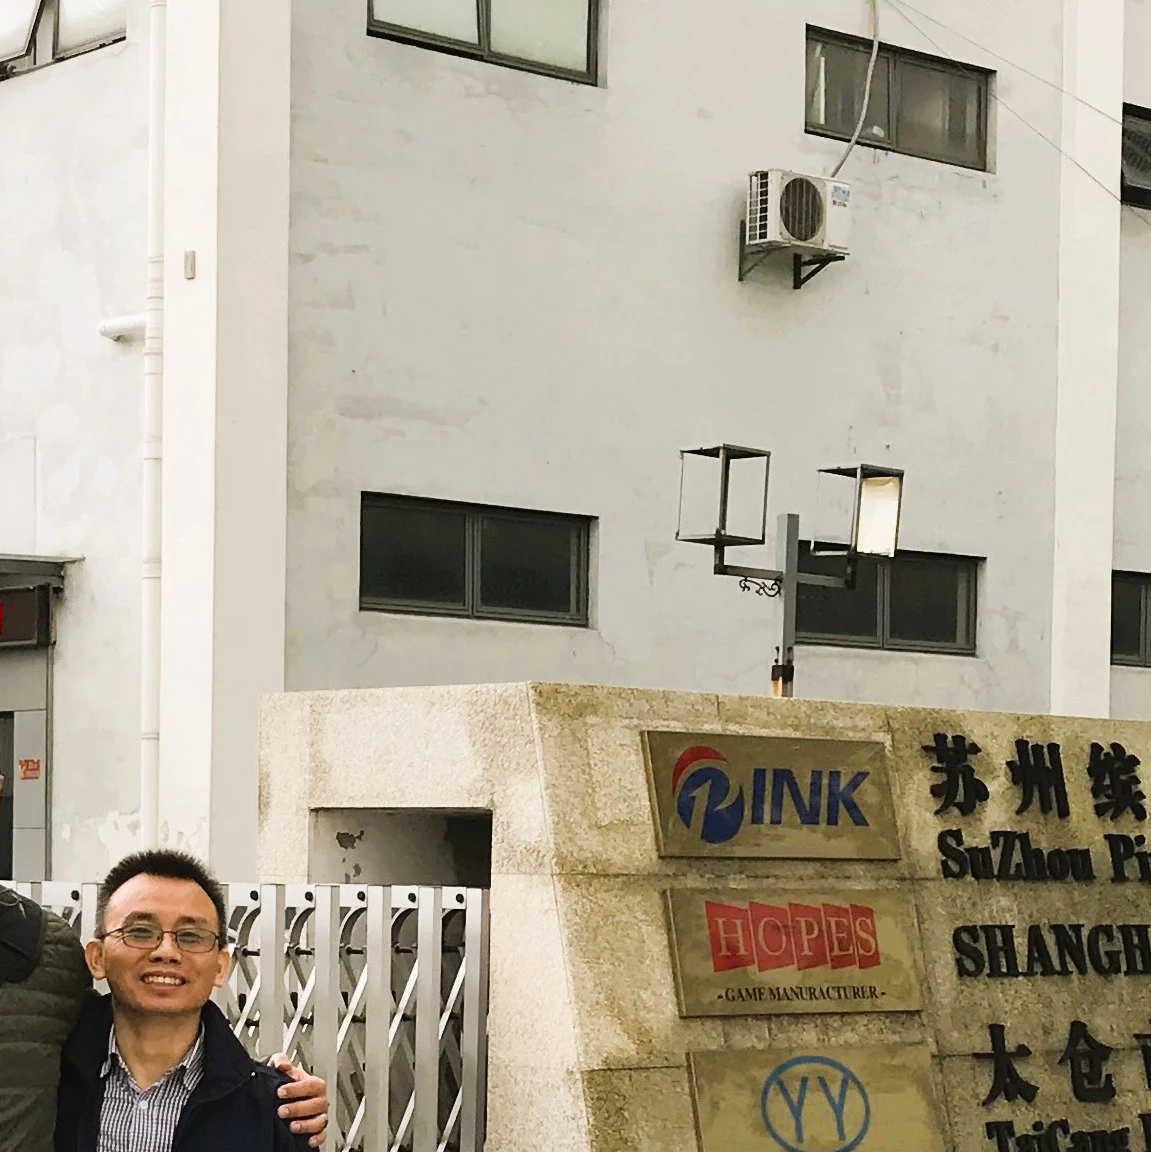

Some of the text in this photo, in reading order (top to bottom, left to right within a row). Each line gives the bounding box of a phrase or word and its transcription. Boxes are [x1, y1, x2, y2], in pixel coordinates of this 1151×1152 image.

[937, 829, 1151, 883] SuZhou Pi
[715, 917, 877, 956] HOPES
[777, 1076, 849, 1143] YY
